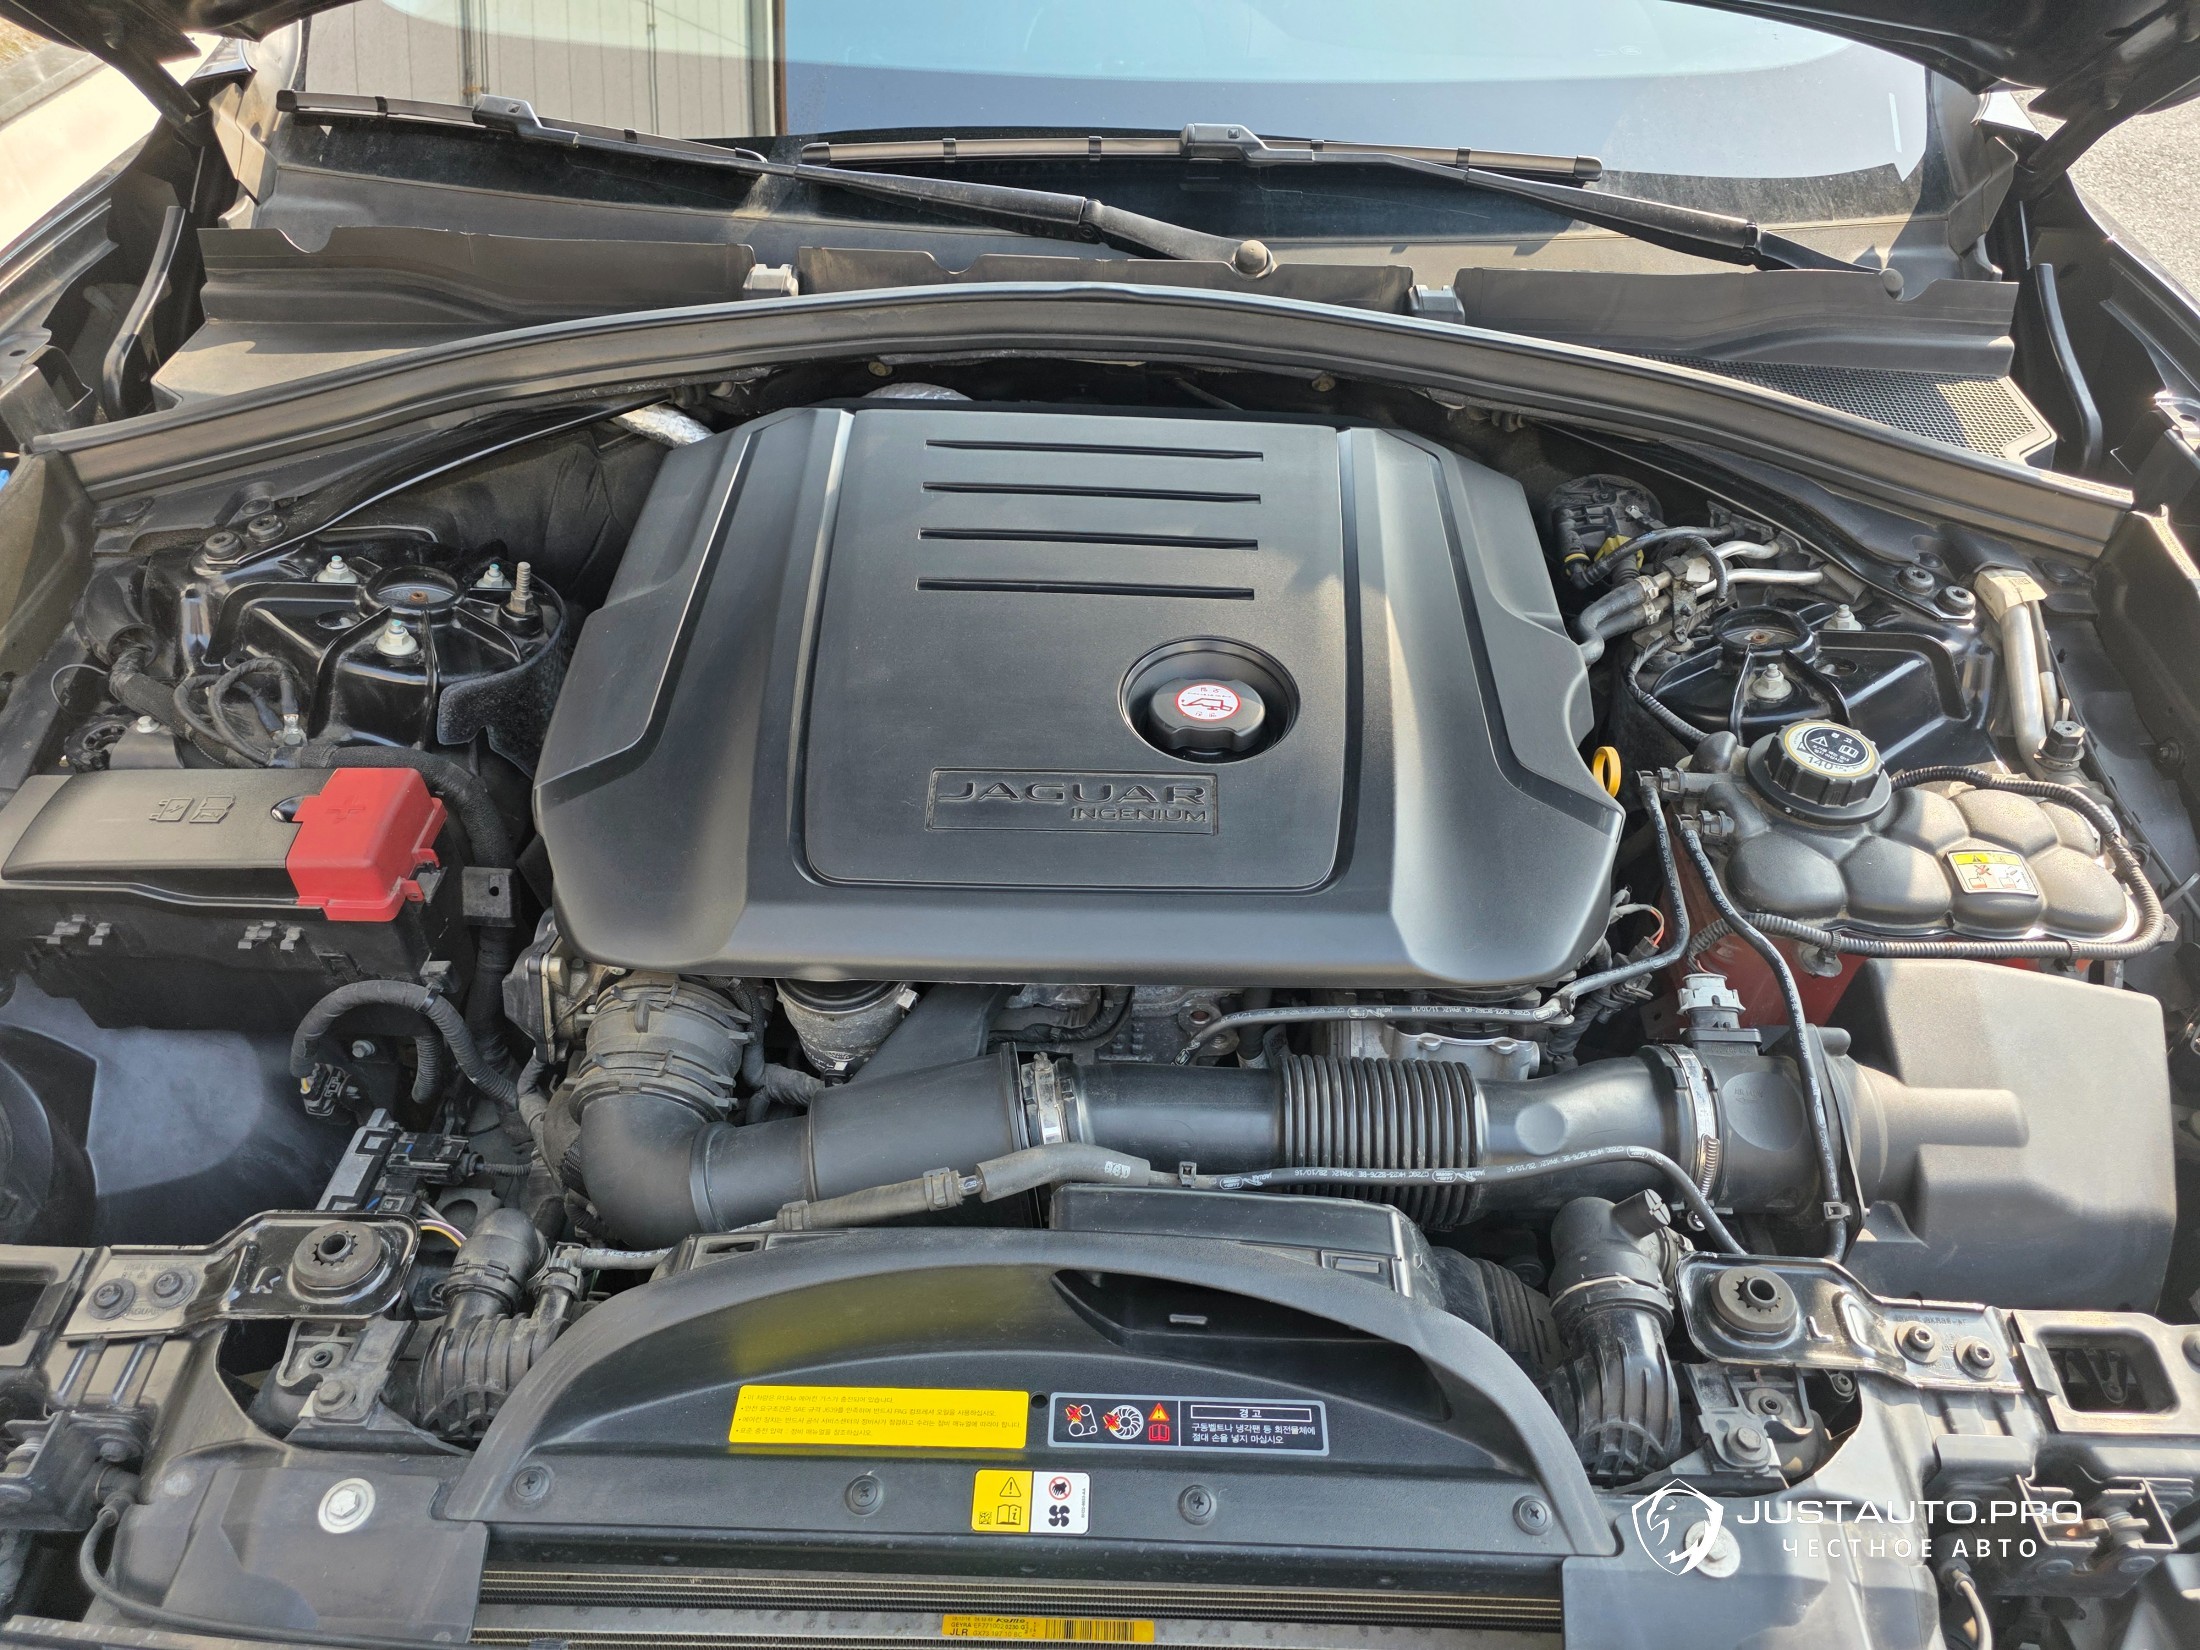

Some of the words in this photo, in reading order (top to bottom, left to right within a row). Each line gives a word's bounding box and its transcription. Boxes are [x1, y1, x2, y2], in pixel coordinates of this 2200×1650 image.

[939, 782, 1205, 804] JAGUAR
[1071, 807, 1207, 823] INGENIUM
[1192, 1423, 1233, 1433] 구동벨트나
[1236, 1424, 1261, 1433] 냉각팬
[1263, 1425, 1272, 1433] 등
[1274, 1426, 1315, 1435] 회전물체에
[1192, 1433, 1209, 1442] 절대
[1212, 1434, 1228, 1442] 손을
[1231, 1434, 1248, 1443] 넣지
[1250, 1435, 1284, 1444] 마십시오
